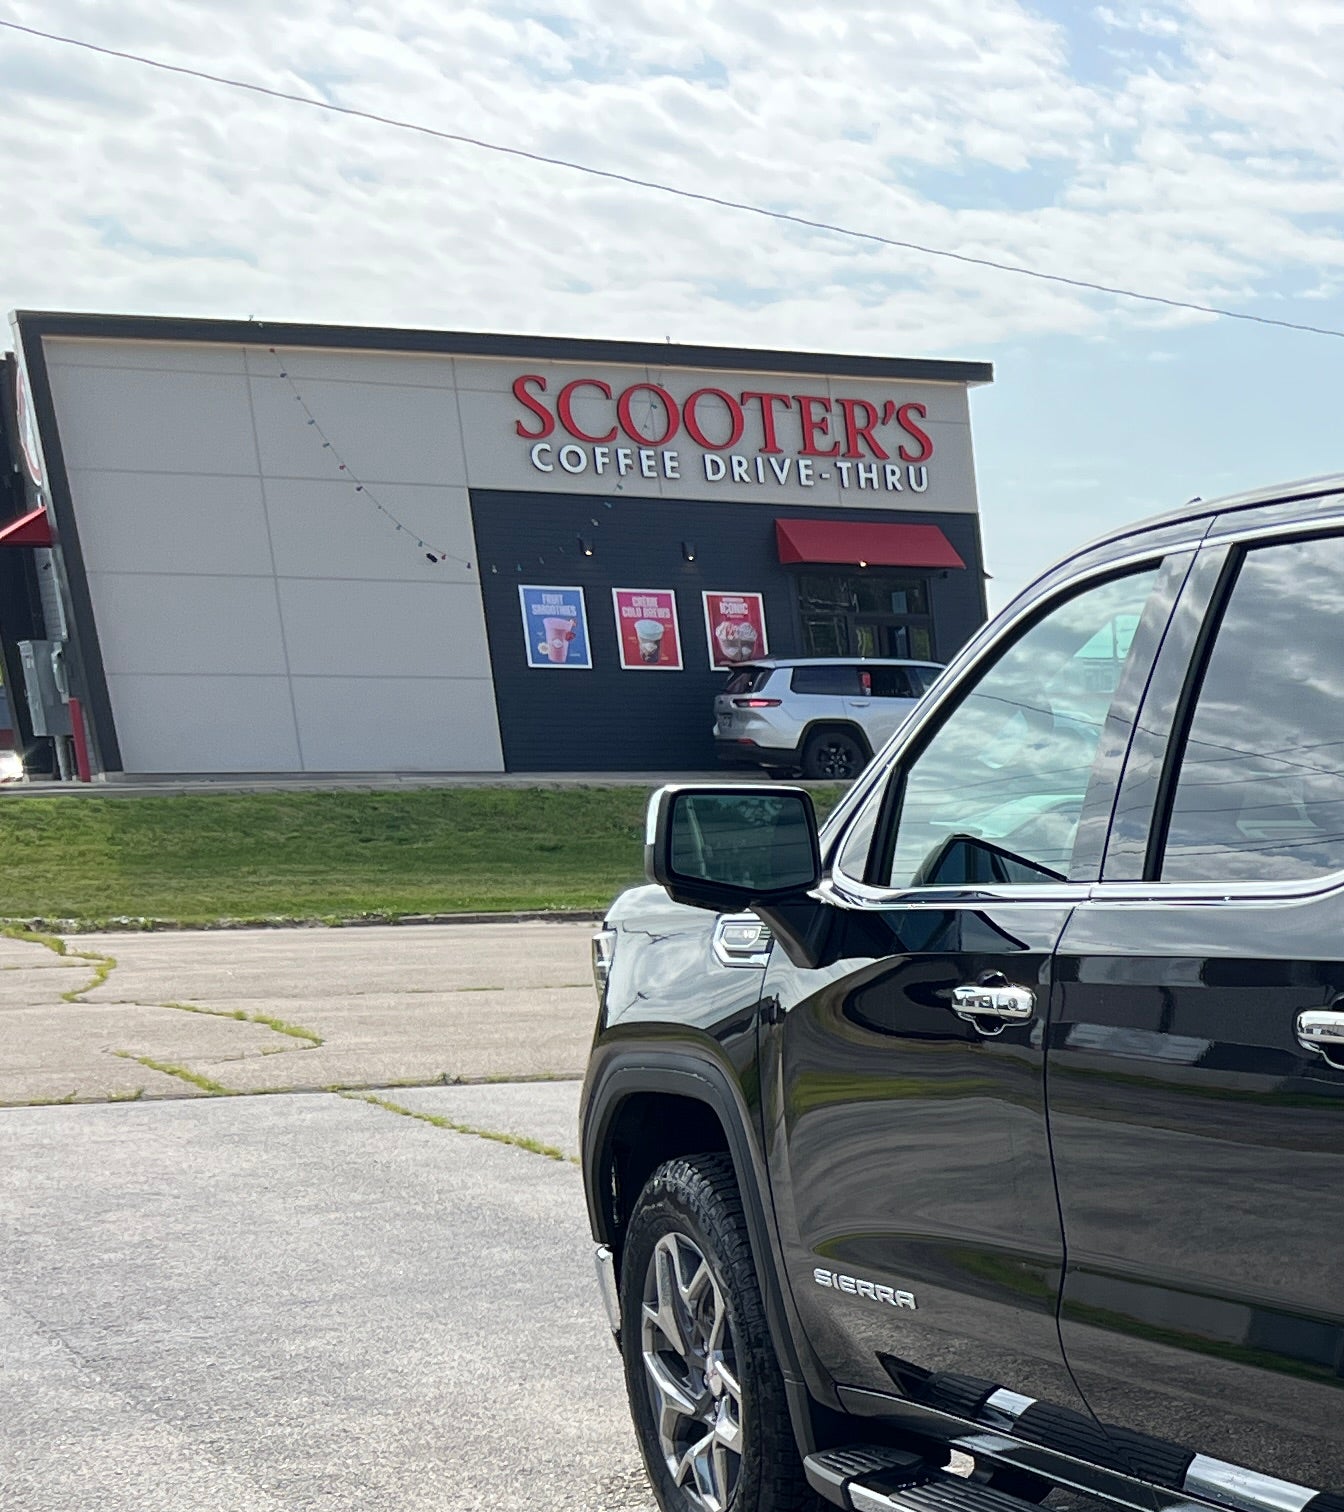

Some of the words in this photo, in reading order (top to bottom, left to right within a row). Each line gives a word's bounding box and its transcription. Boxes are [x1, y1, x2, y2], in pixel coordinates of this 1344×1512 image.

[512, 374, 934, 462] SCOOTER'S
[530, 442, 681, 479] COFFEE
[703, 454, 929, 493] DRIVE-THRU
[813, 1267, 919, 1310] SIERRA
